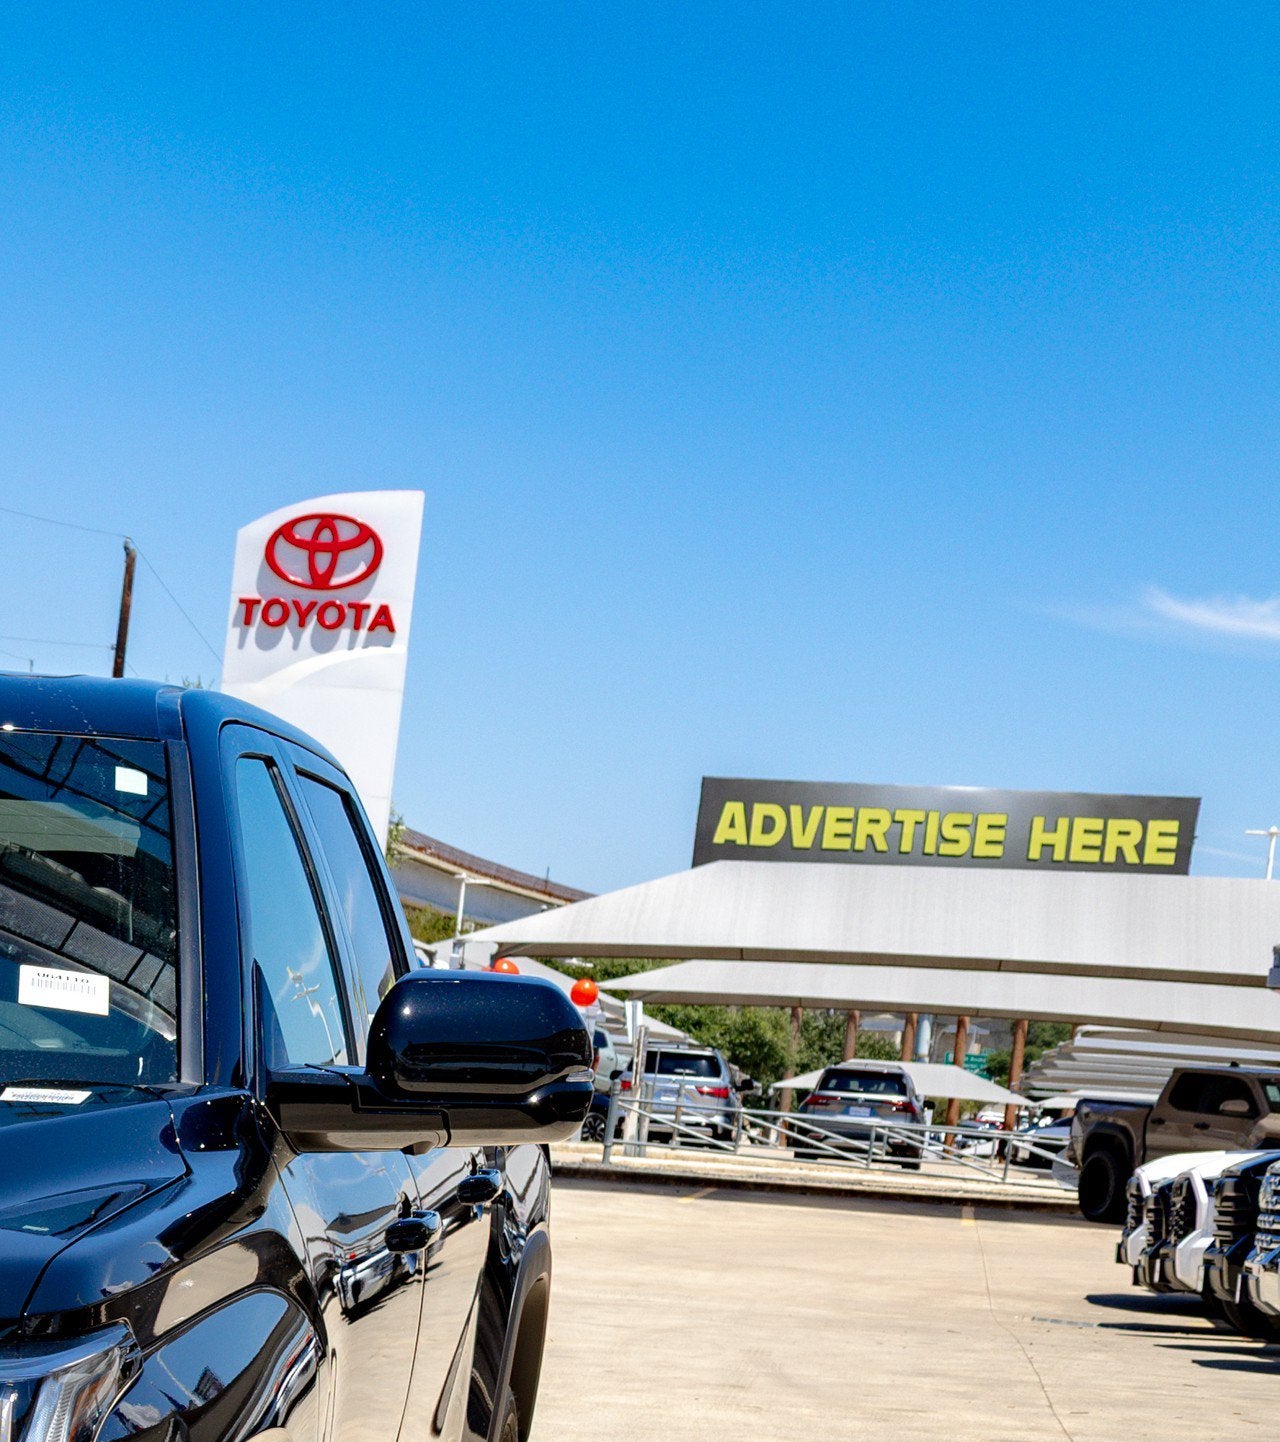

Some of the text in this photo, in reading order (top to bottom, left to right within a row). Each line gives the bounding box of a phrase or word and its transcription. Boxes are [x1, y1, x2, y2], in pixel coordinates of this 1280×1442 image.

[238, 597, 395, 633] TOYOTA
[712, 801, 1180, 866] ADVERTISE HERE
